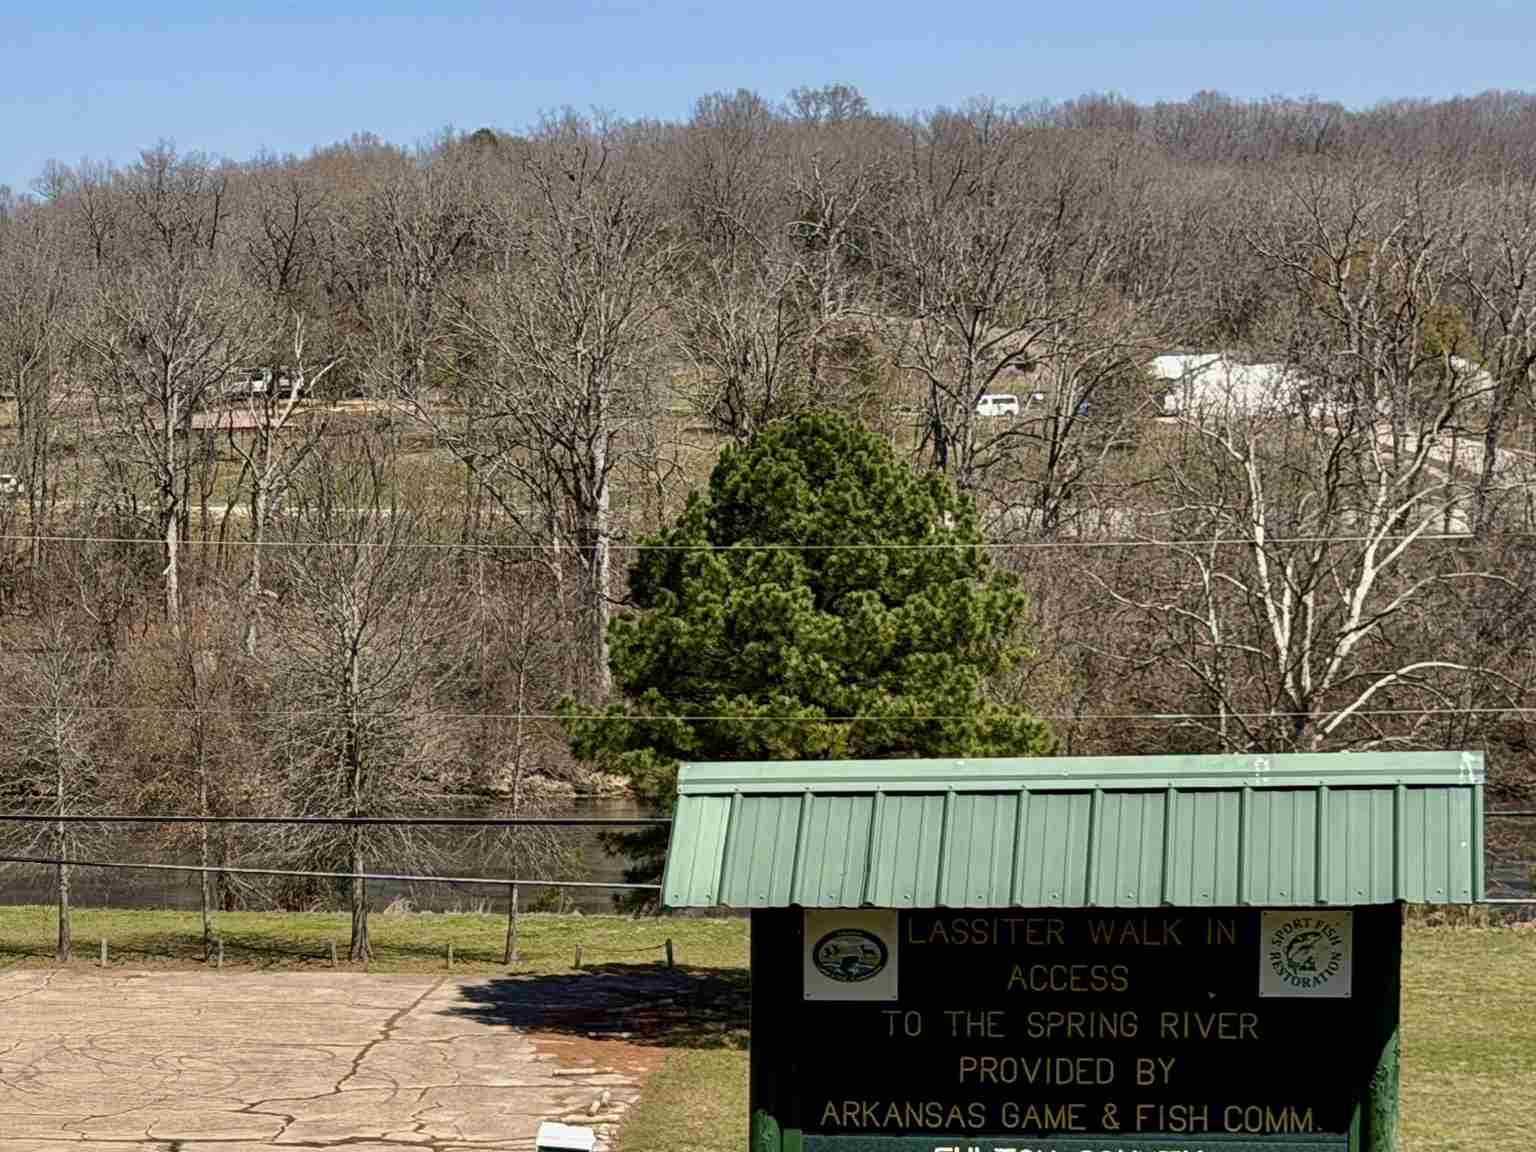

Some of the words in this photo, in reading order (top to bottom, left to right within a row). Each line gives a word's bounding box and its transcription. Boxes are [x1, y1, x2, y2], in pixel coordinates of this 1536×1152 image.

[909, 919, 1064, 944] LASSITER
[1089, 920, 1181, 945] WALK
[1208, 920, 1234, 944] IN
[1272, 918, 1313, 945] SPORT
[1314, 919, 1343, 946] FISH
[1008, 965, 1128, 991] ACCESS
[1269, 951, 1343, 989] RESTORATION
[882, 1010, 921, 1036] TO
[944, 1011, 1005, 1037] THE
[1028, 1011, 1138, 1038] SPRING
[1161, 1012, 1258, 1039] RIVER
[960, 1056, 1114, 1085] PROVIDED
[1136, 1057, 1175, 1085] BY
[820, 1101, 986, 1128] ARKANSAS
[1002, 1102, 1086, 1130] GAME
[1102, 1103, 1120, 1130] &
[1137, 1104, 1208, 1132] FISH
[1224, 1105, 1322, 1133] COMM.
